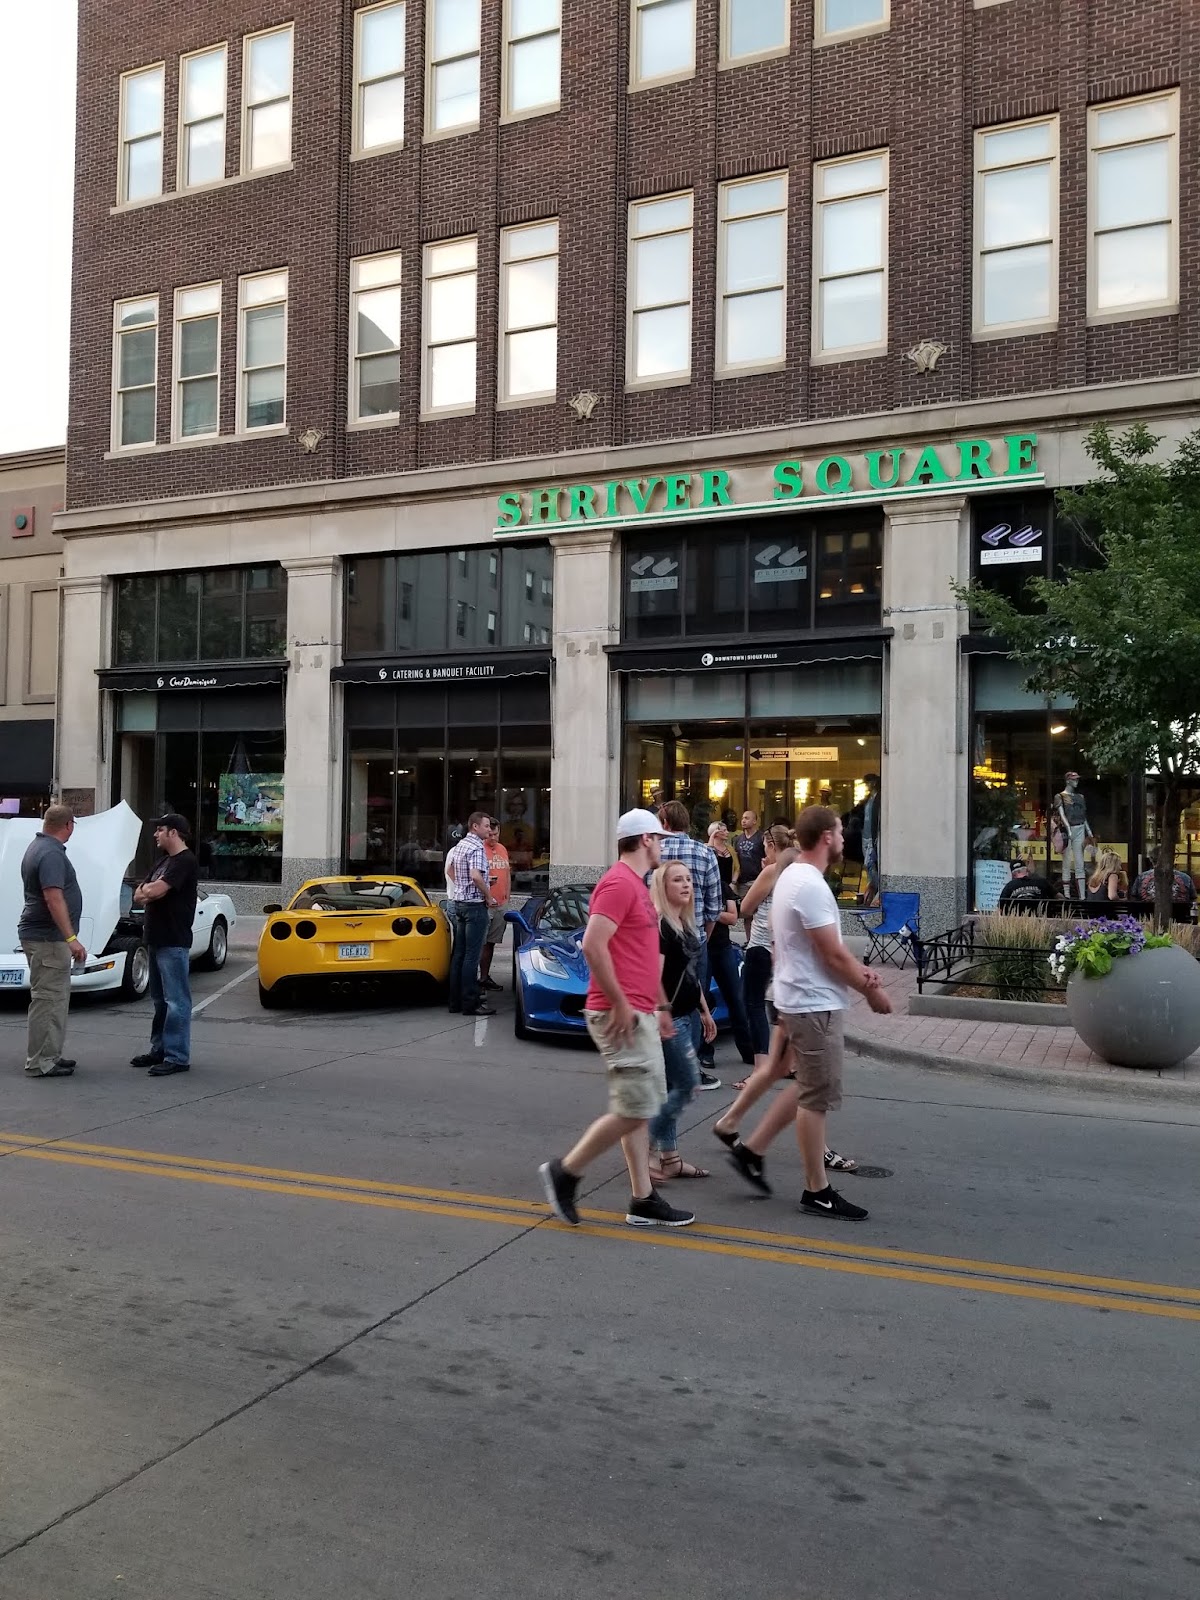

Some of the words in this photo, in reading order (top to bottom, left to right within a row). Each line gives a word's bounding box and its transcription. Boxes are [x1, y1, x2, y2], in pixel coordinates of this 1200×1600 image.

[497, 469, 734, 528] SHRIVER
[773, 432, 1039, 501] SQUARE
[392, 669, 423, 679] CATERING
[425, 669, 431, 678] &
[432, 667, 463, 678] BANQUET
[465, 665, 495, 676] FACILITY
